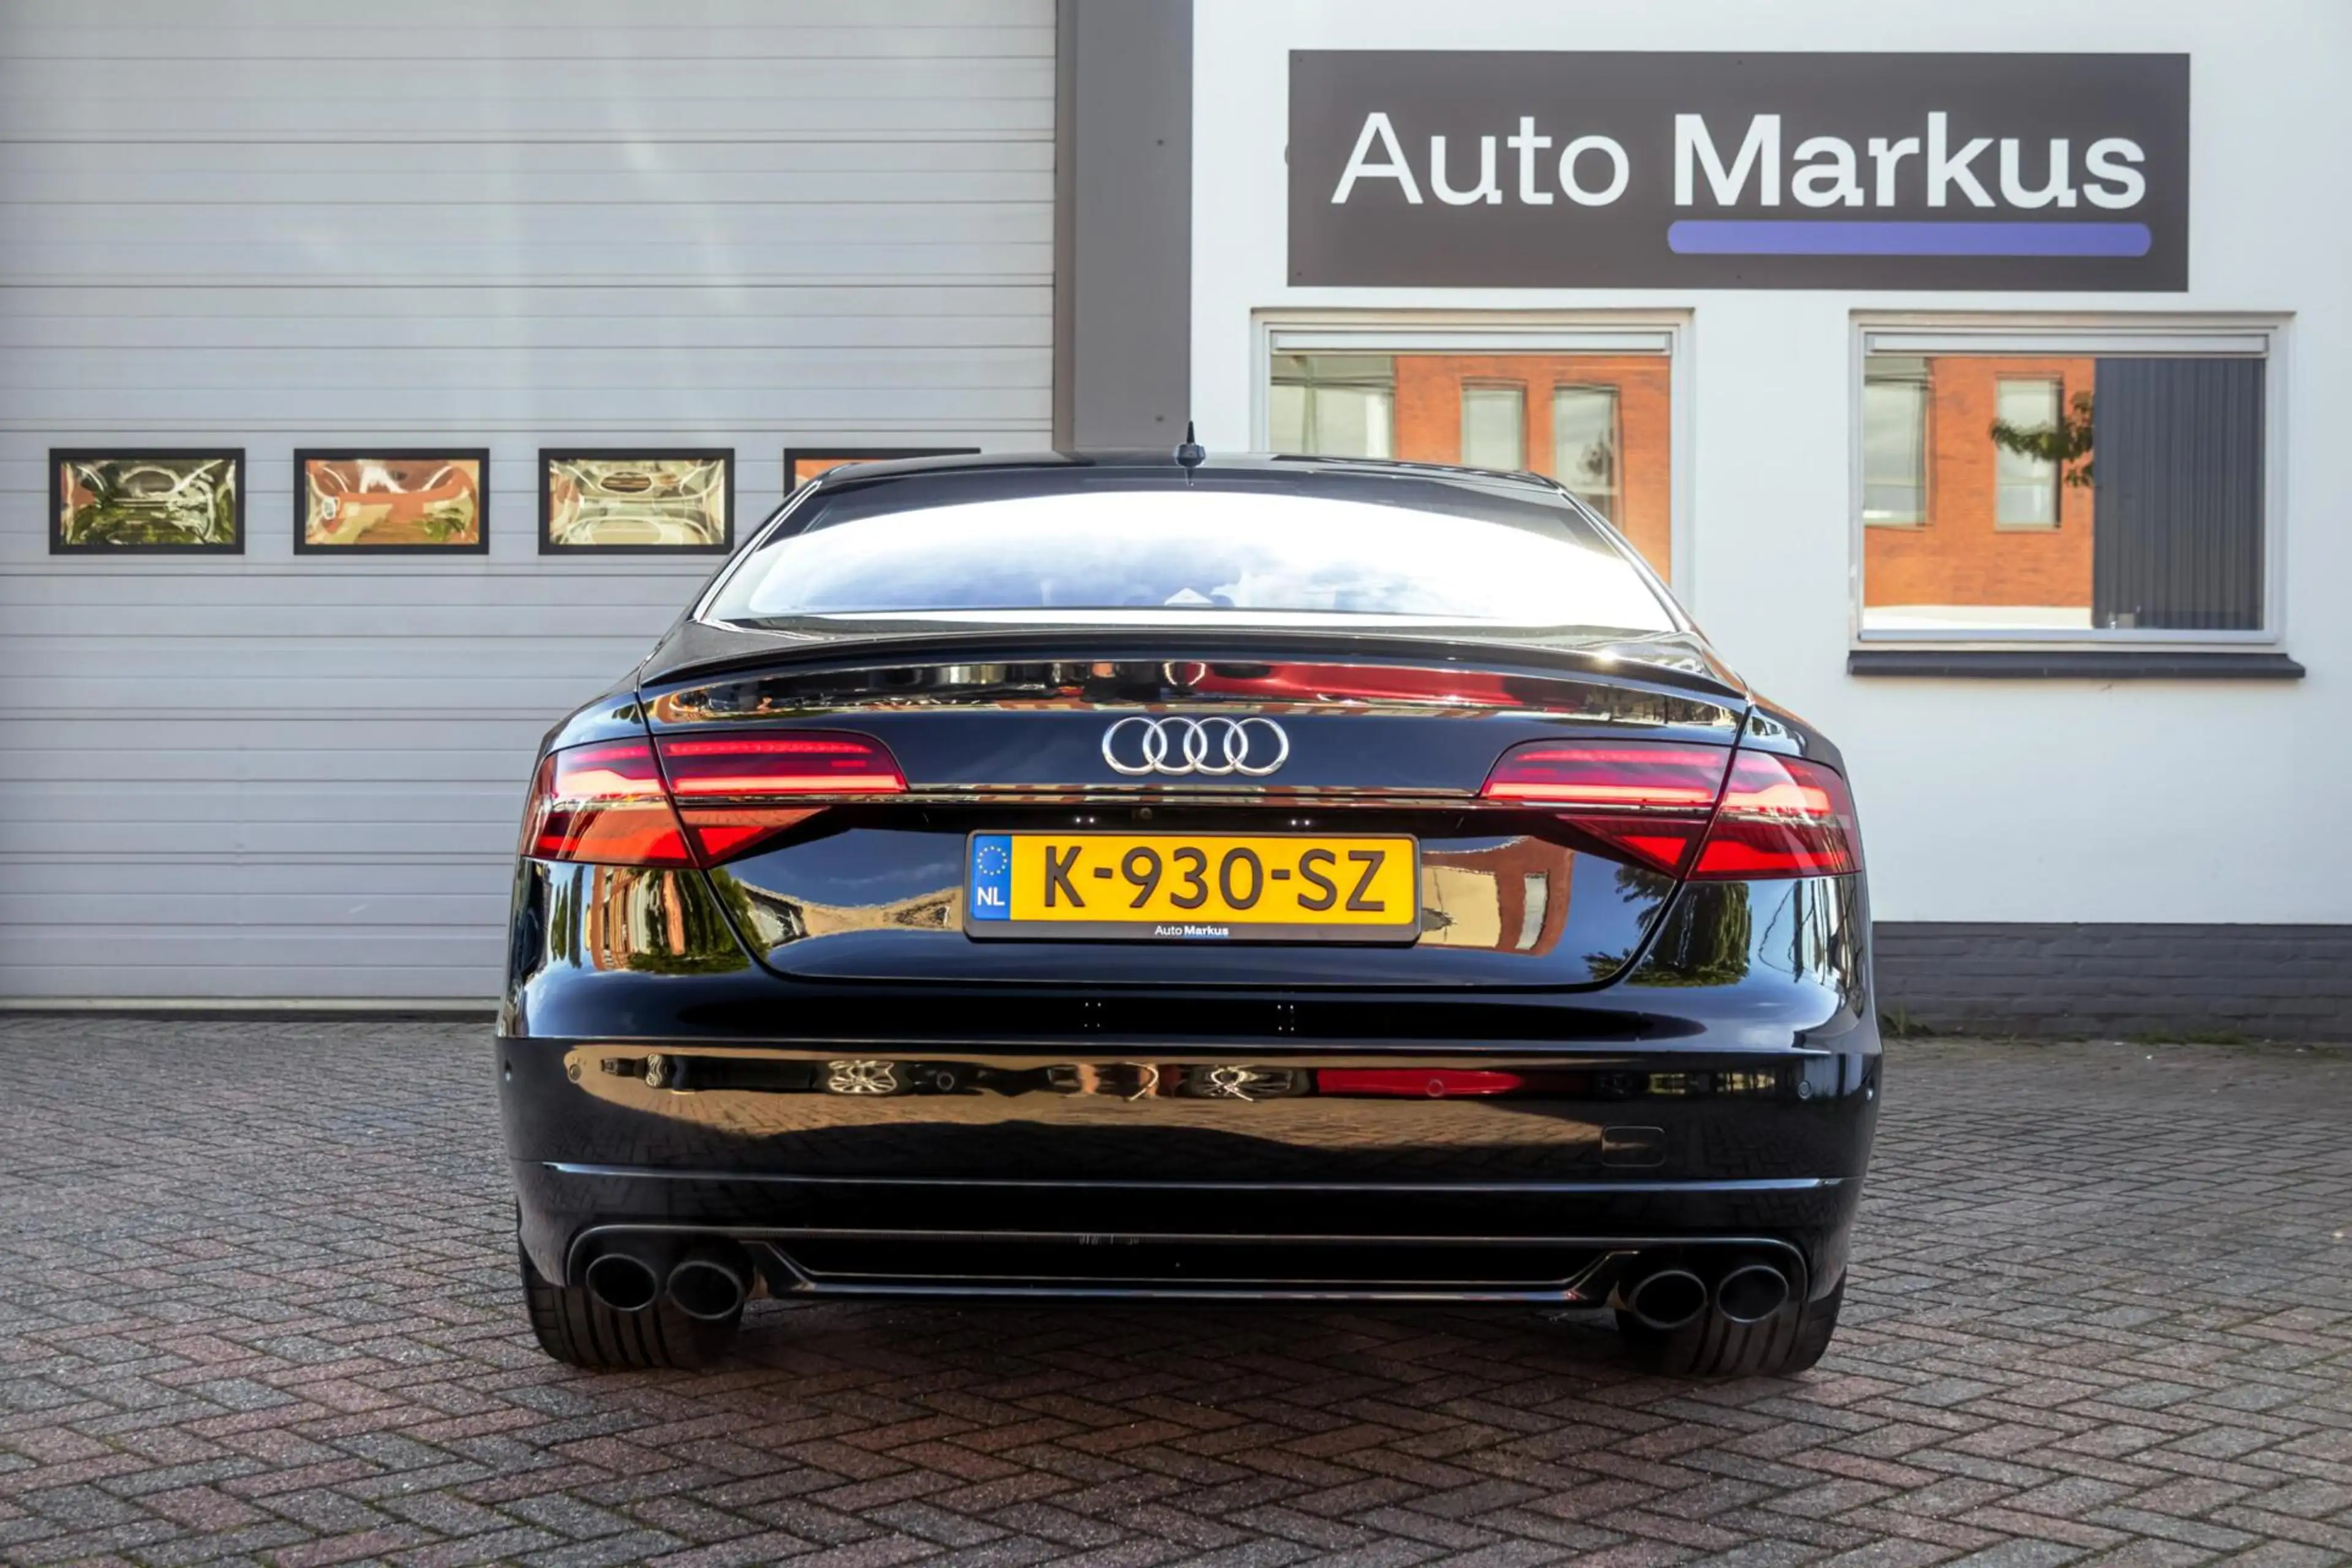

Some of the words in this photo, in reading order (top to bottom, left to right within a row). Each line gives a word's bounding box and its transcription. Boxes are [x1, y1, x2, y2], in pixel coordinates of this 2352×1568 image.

[1331, 112, 1629, 206] Auto
[1675, 111, 2146, 209] Markus
[977, 886, 1005, 906] NL
[1044, 845, 1385, 912] K-930-SZ
[1155, 925, 1183, 935] Auto
[1184, 925, 1229, 936] Markus
